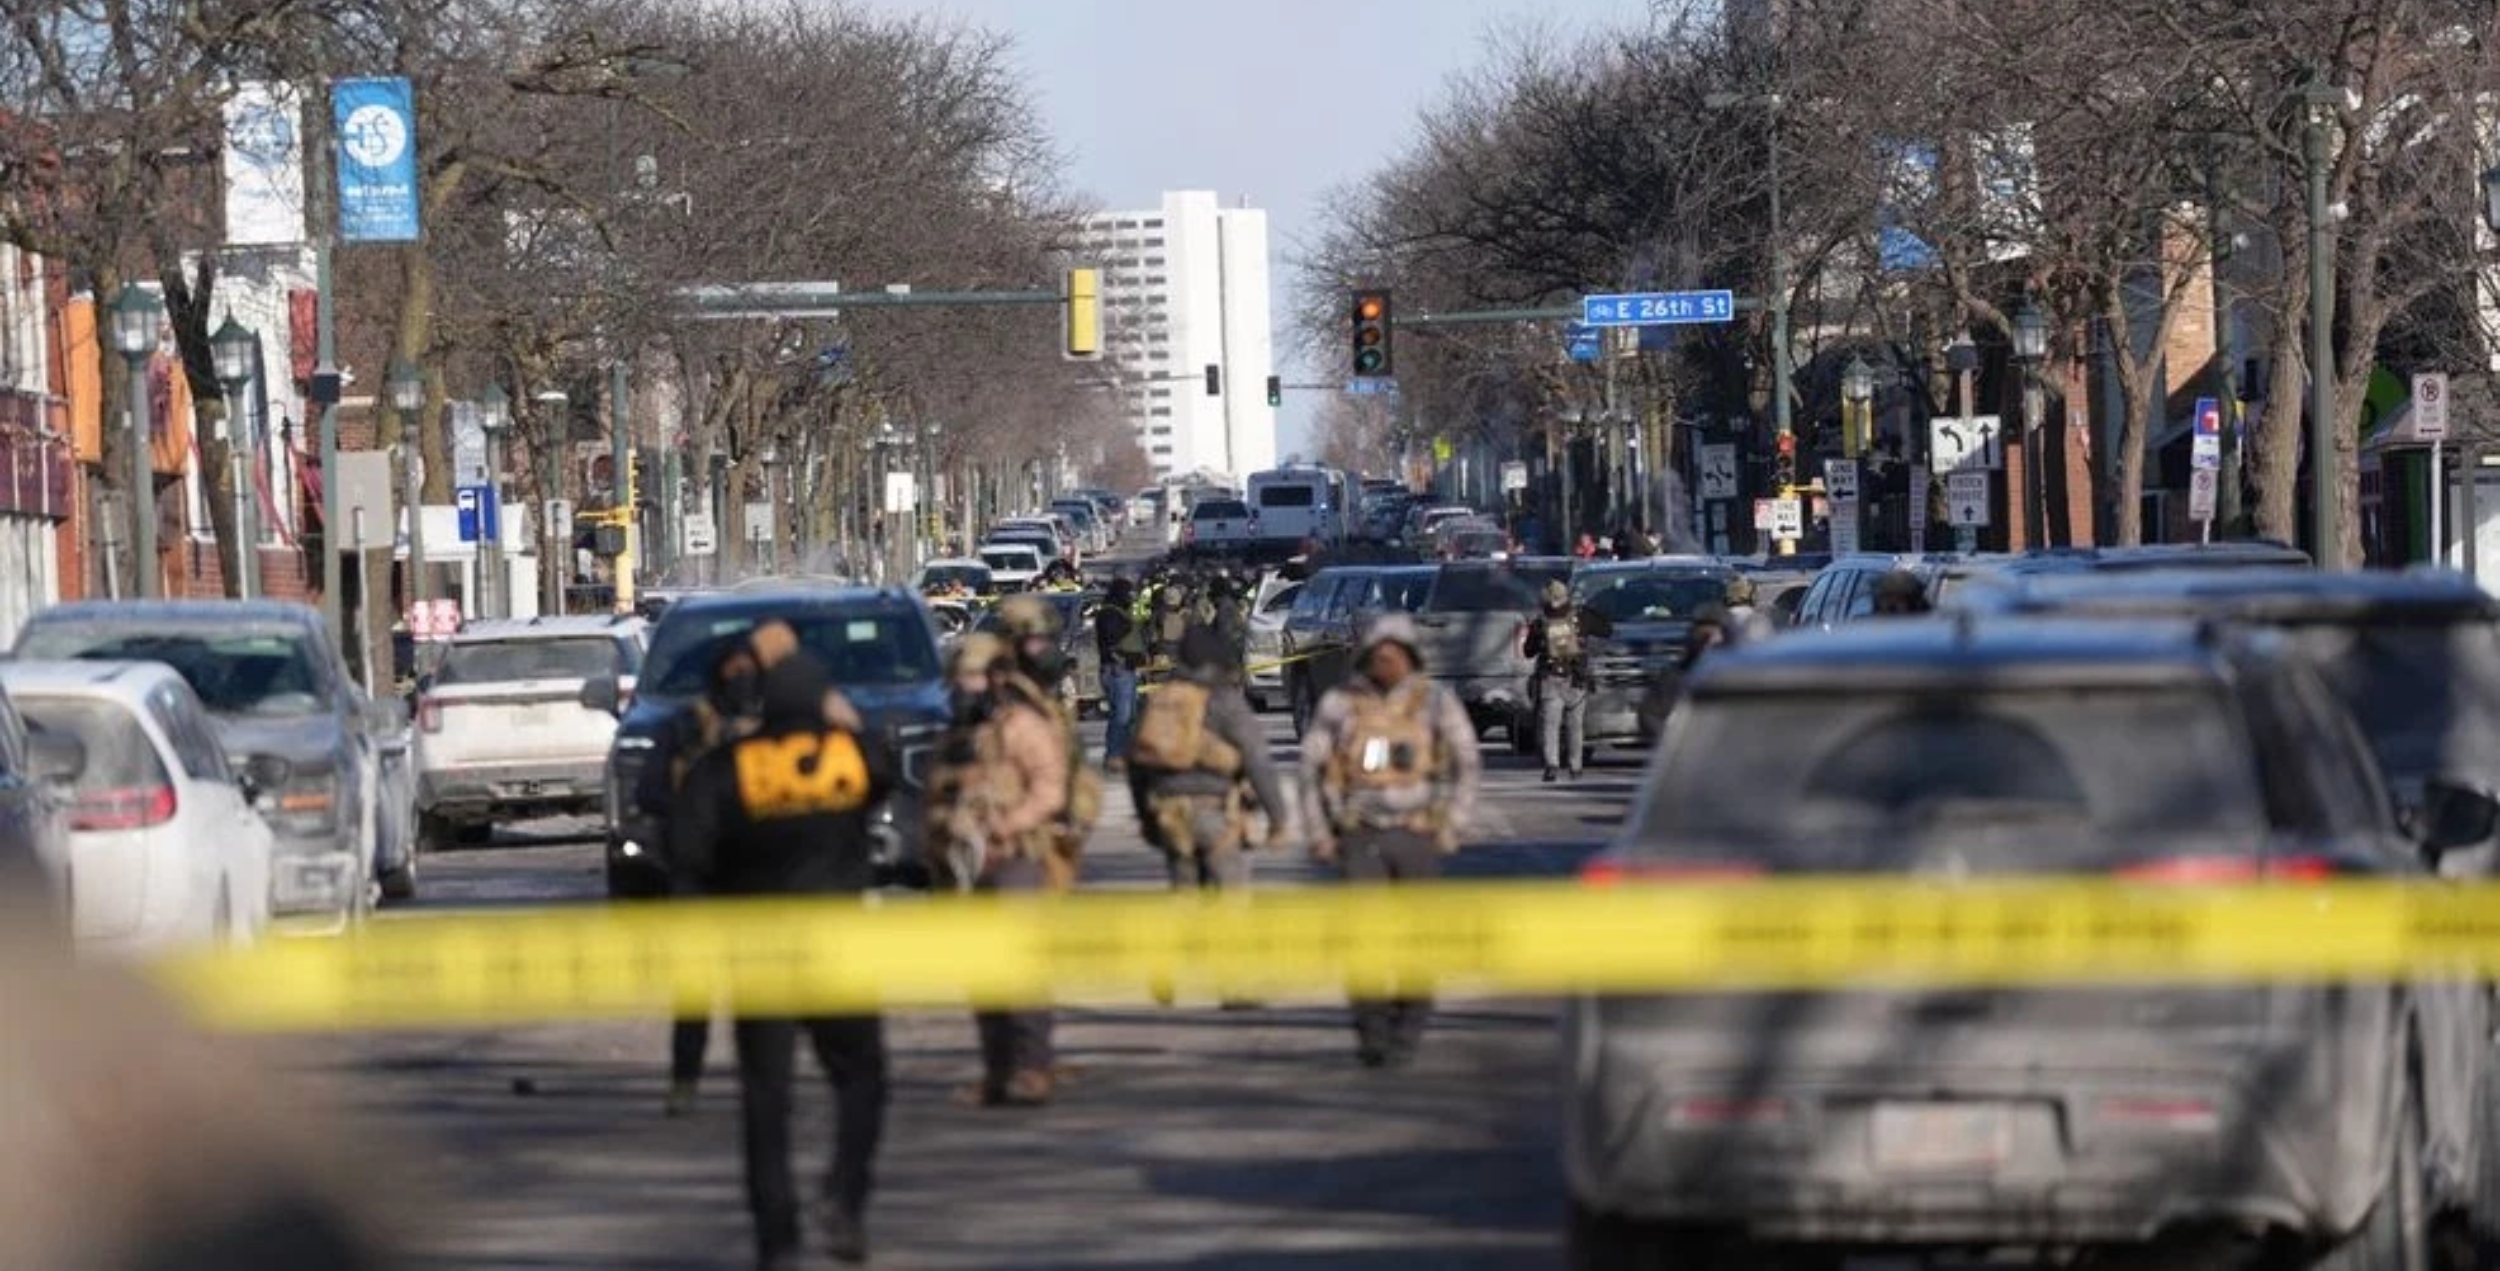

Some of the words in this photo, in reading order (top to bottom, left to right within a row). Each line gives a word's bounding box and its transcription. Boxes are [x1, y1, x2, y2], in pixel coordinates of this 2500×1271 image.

[1617, 301, 1631, 319] E
[1639, 299, 1693, 318] 26th
[1702, 297, 1727, 315] St
[732, 729, 870, 803] BCA
